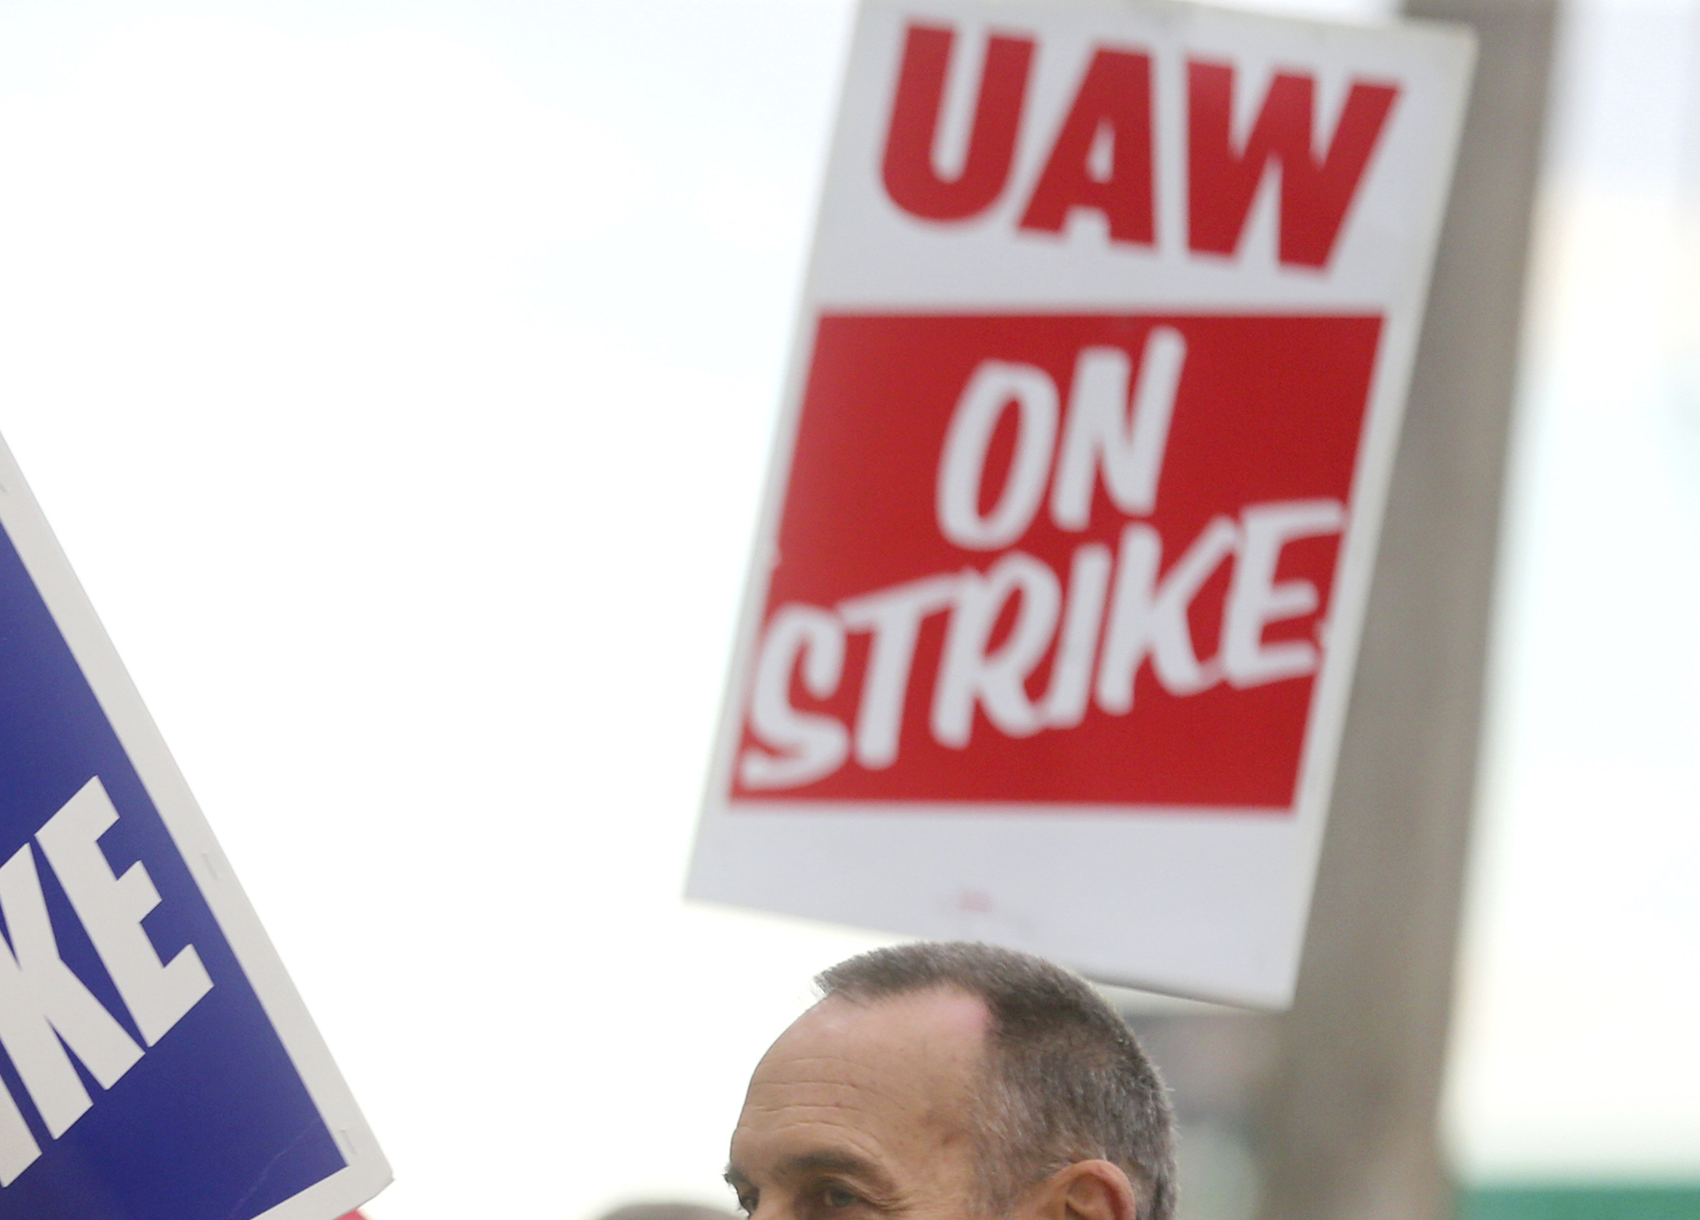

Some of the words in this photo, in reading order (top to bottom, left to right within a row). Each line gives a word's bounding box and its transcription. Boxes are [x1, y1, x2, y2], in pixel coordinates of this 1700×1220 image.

[878, 20, 1404, 277] UAW
[934, 325, 1188, 552] ON
[736, 496, 1352, 790] STRIKE
